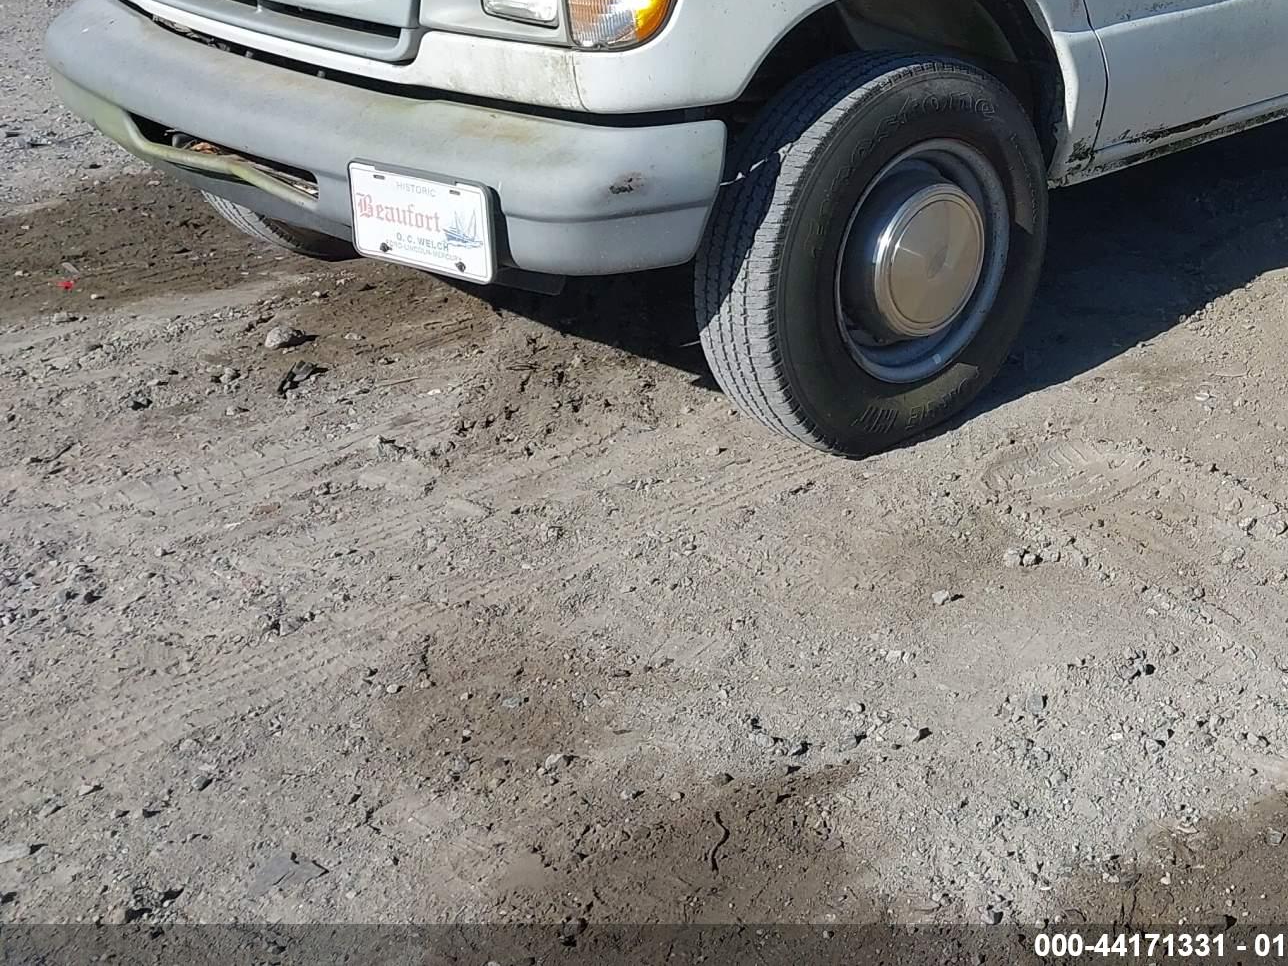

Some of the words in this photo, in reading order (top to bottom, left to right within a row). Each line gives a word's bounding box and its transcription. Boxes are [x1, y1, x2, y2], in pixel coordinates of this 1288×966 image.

[396, 181, 437, 198] HISTORIC
[356, 191, 441, 233] Beaufort
[406, 234, 416, 245] C.
[417, 236, 449, 252] WELCH
